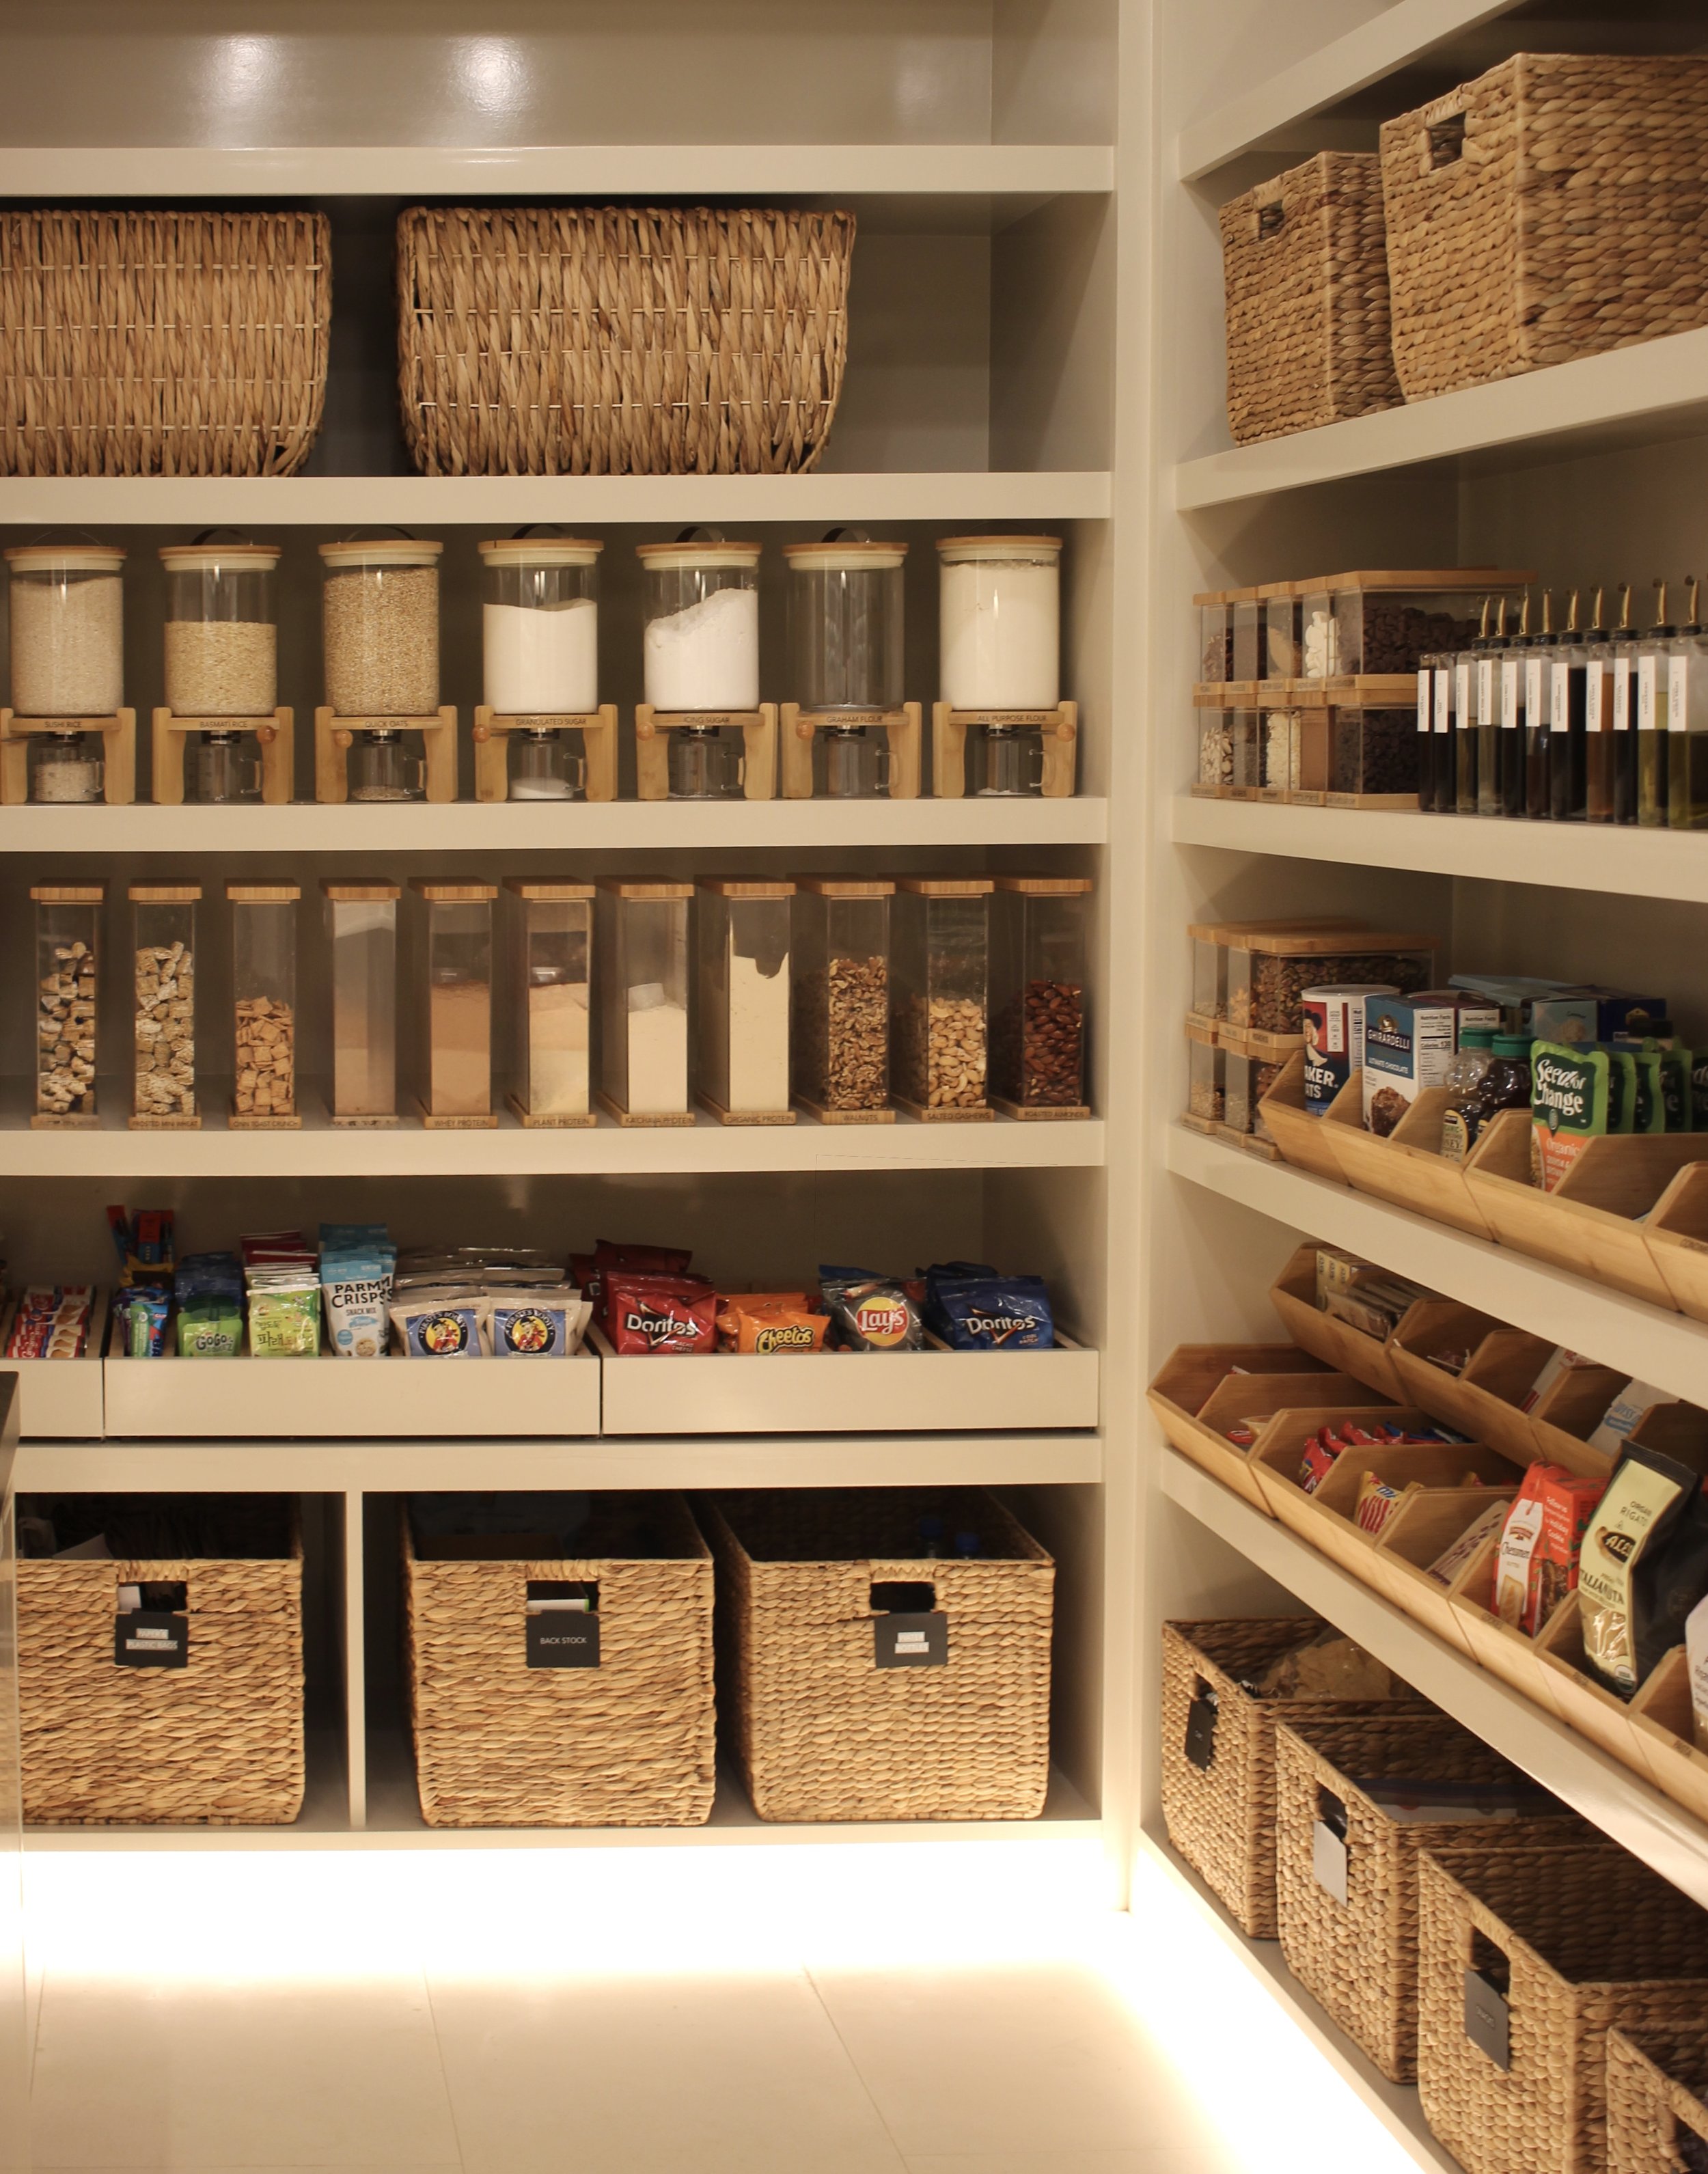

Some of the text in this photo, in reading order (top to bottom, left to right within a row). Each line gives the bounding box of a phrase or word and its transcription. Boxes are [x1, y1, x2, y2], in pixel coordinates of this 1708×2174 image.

[1368, 1030, 1410, 1049] GHIRARDELLI
[1537, 1059, 1576, 1088] Seeds
[1533, 1082, 1584, 1115] Change
[334, 1281, 381, 1294] PARM
[626, 1313, 698, 1337] Doritos
[862, 1308, 905, 1336] Lay's
[965, 1317, 1036, 1336] Doritos
[756, 1325, 813, 1353] Cheetos
